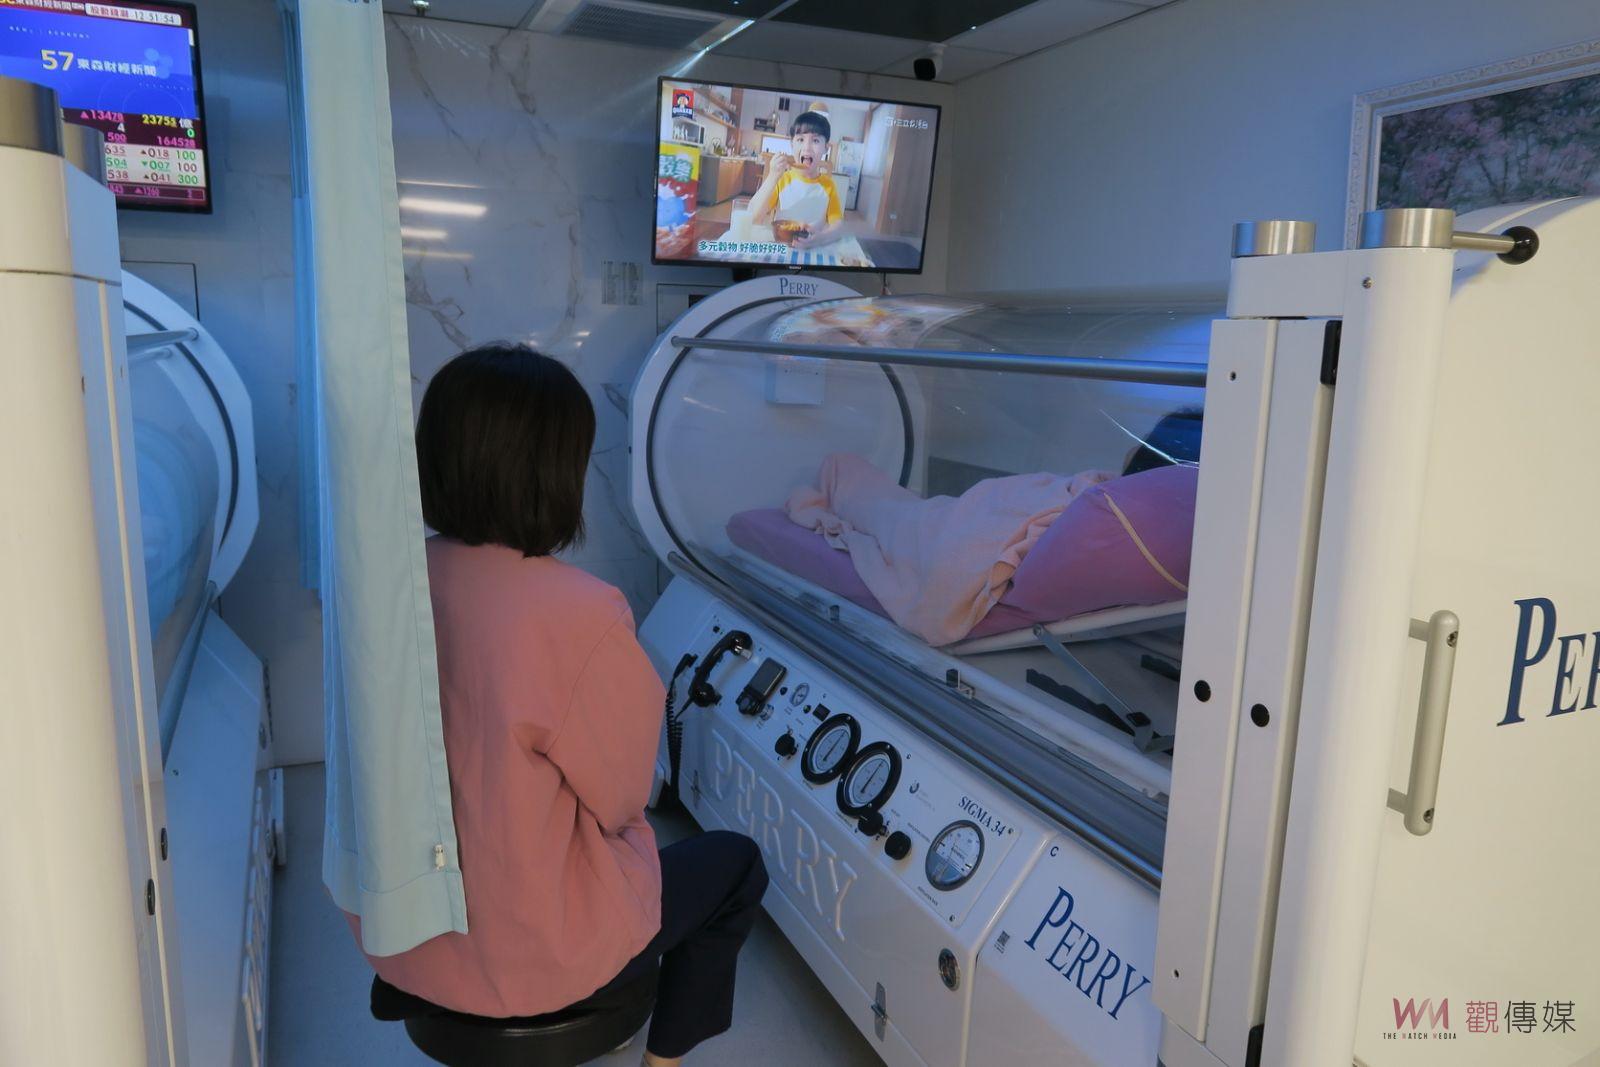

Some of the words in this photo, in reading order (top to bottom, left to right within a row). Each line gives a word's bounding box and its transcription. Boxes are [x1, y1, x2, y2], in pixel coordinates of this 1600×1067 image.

[41, 49, 74, 71] 57
[77, 58, 157, 77] 東森財經新聞
[699, 241, 738, 252] 多元穀物
[779, 276, 819, 296] PERRY
[958, 796, 992, 830] SIGMA
[990, 821, 1006, 837] 34
[1024, 886, 1151, 1021] PERRY
